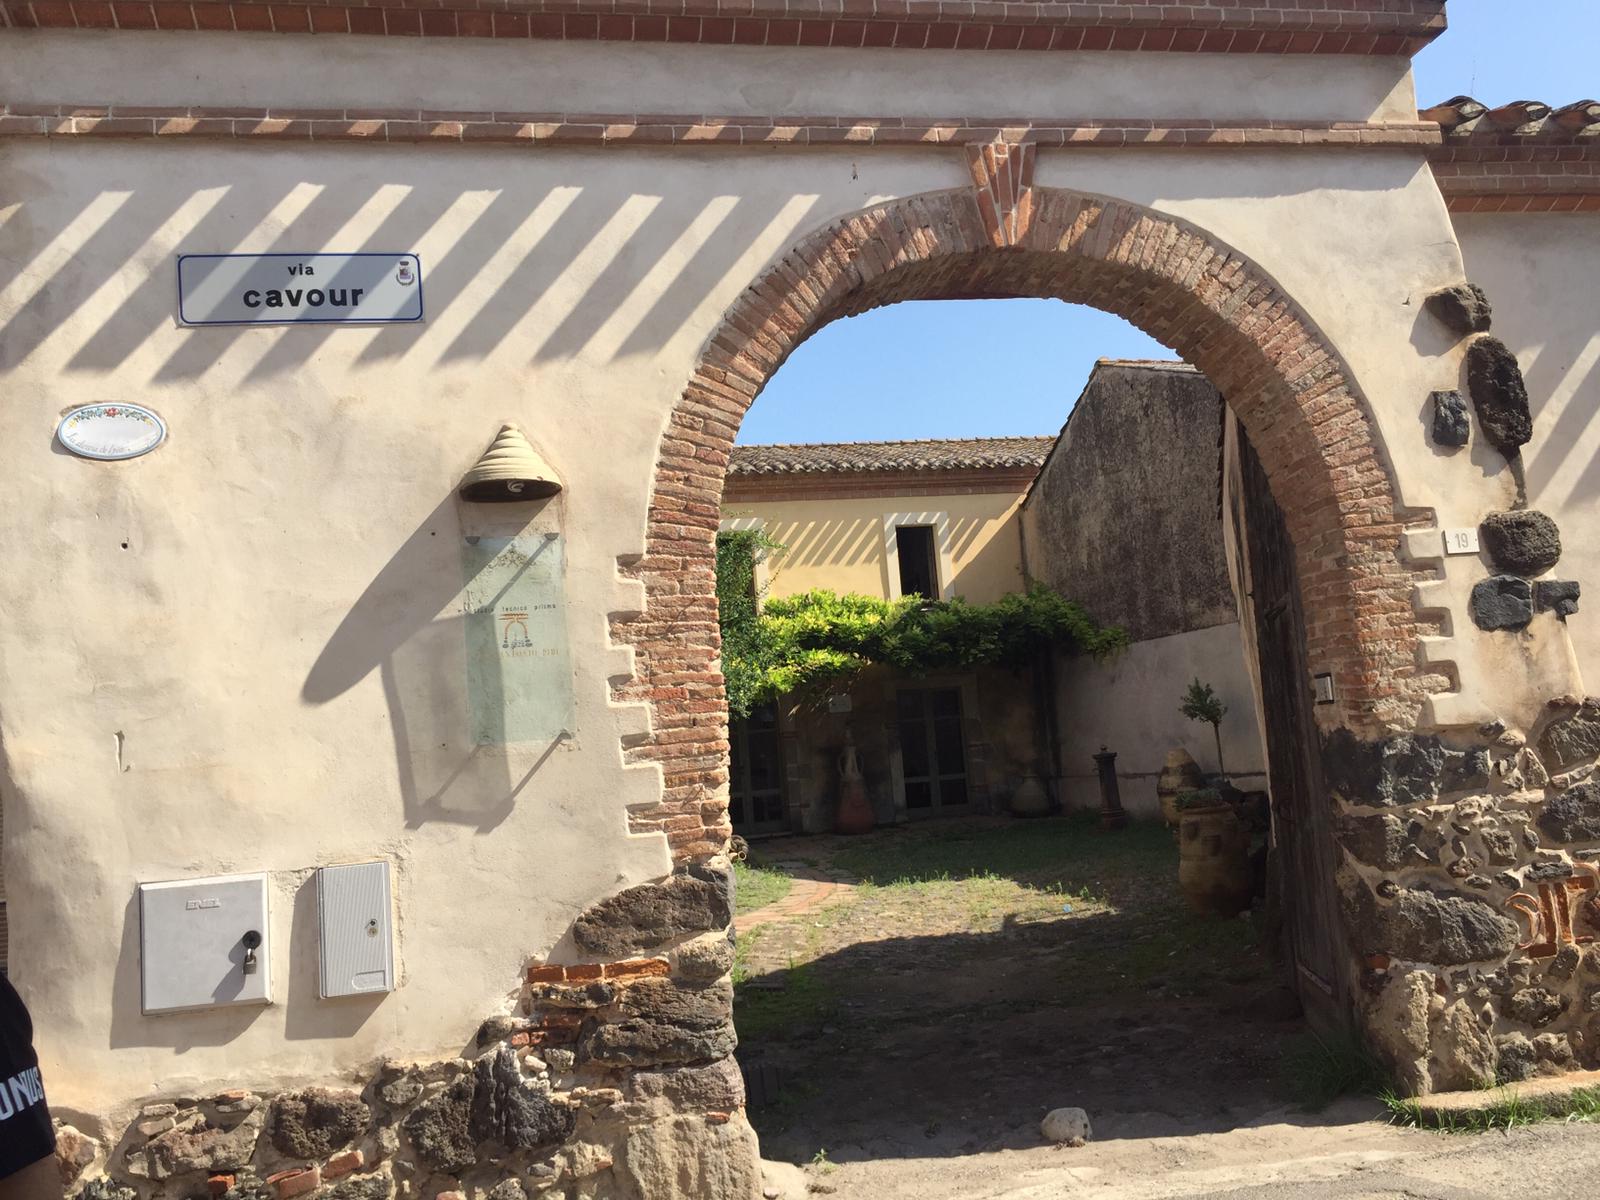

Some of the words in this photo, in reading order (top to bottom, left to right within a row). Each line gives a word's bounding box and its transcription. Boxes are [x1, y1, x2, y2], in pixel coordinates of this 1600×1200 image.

[288, 263, 315, 275] via
[243, 287, 364, 308] cavour
[1455, 532, 1469, 548] 19
